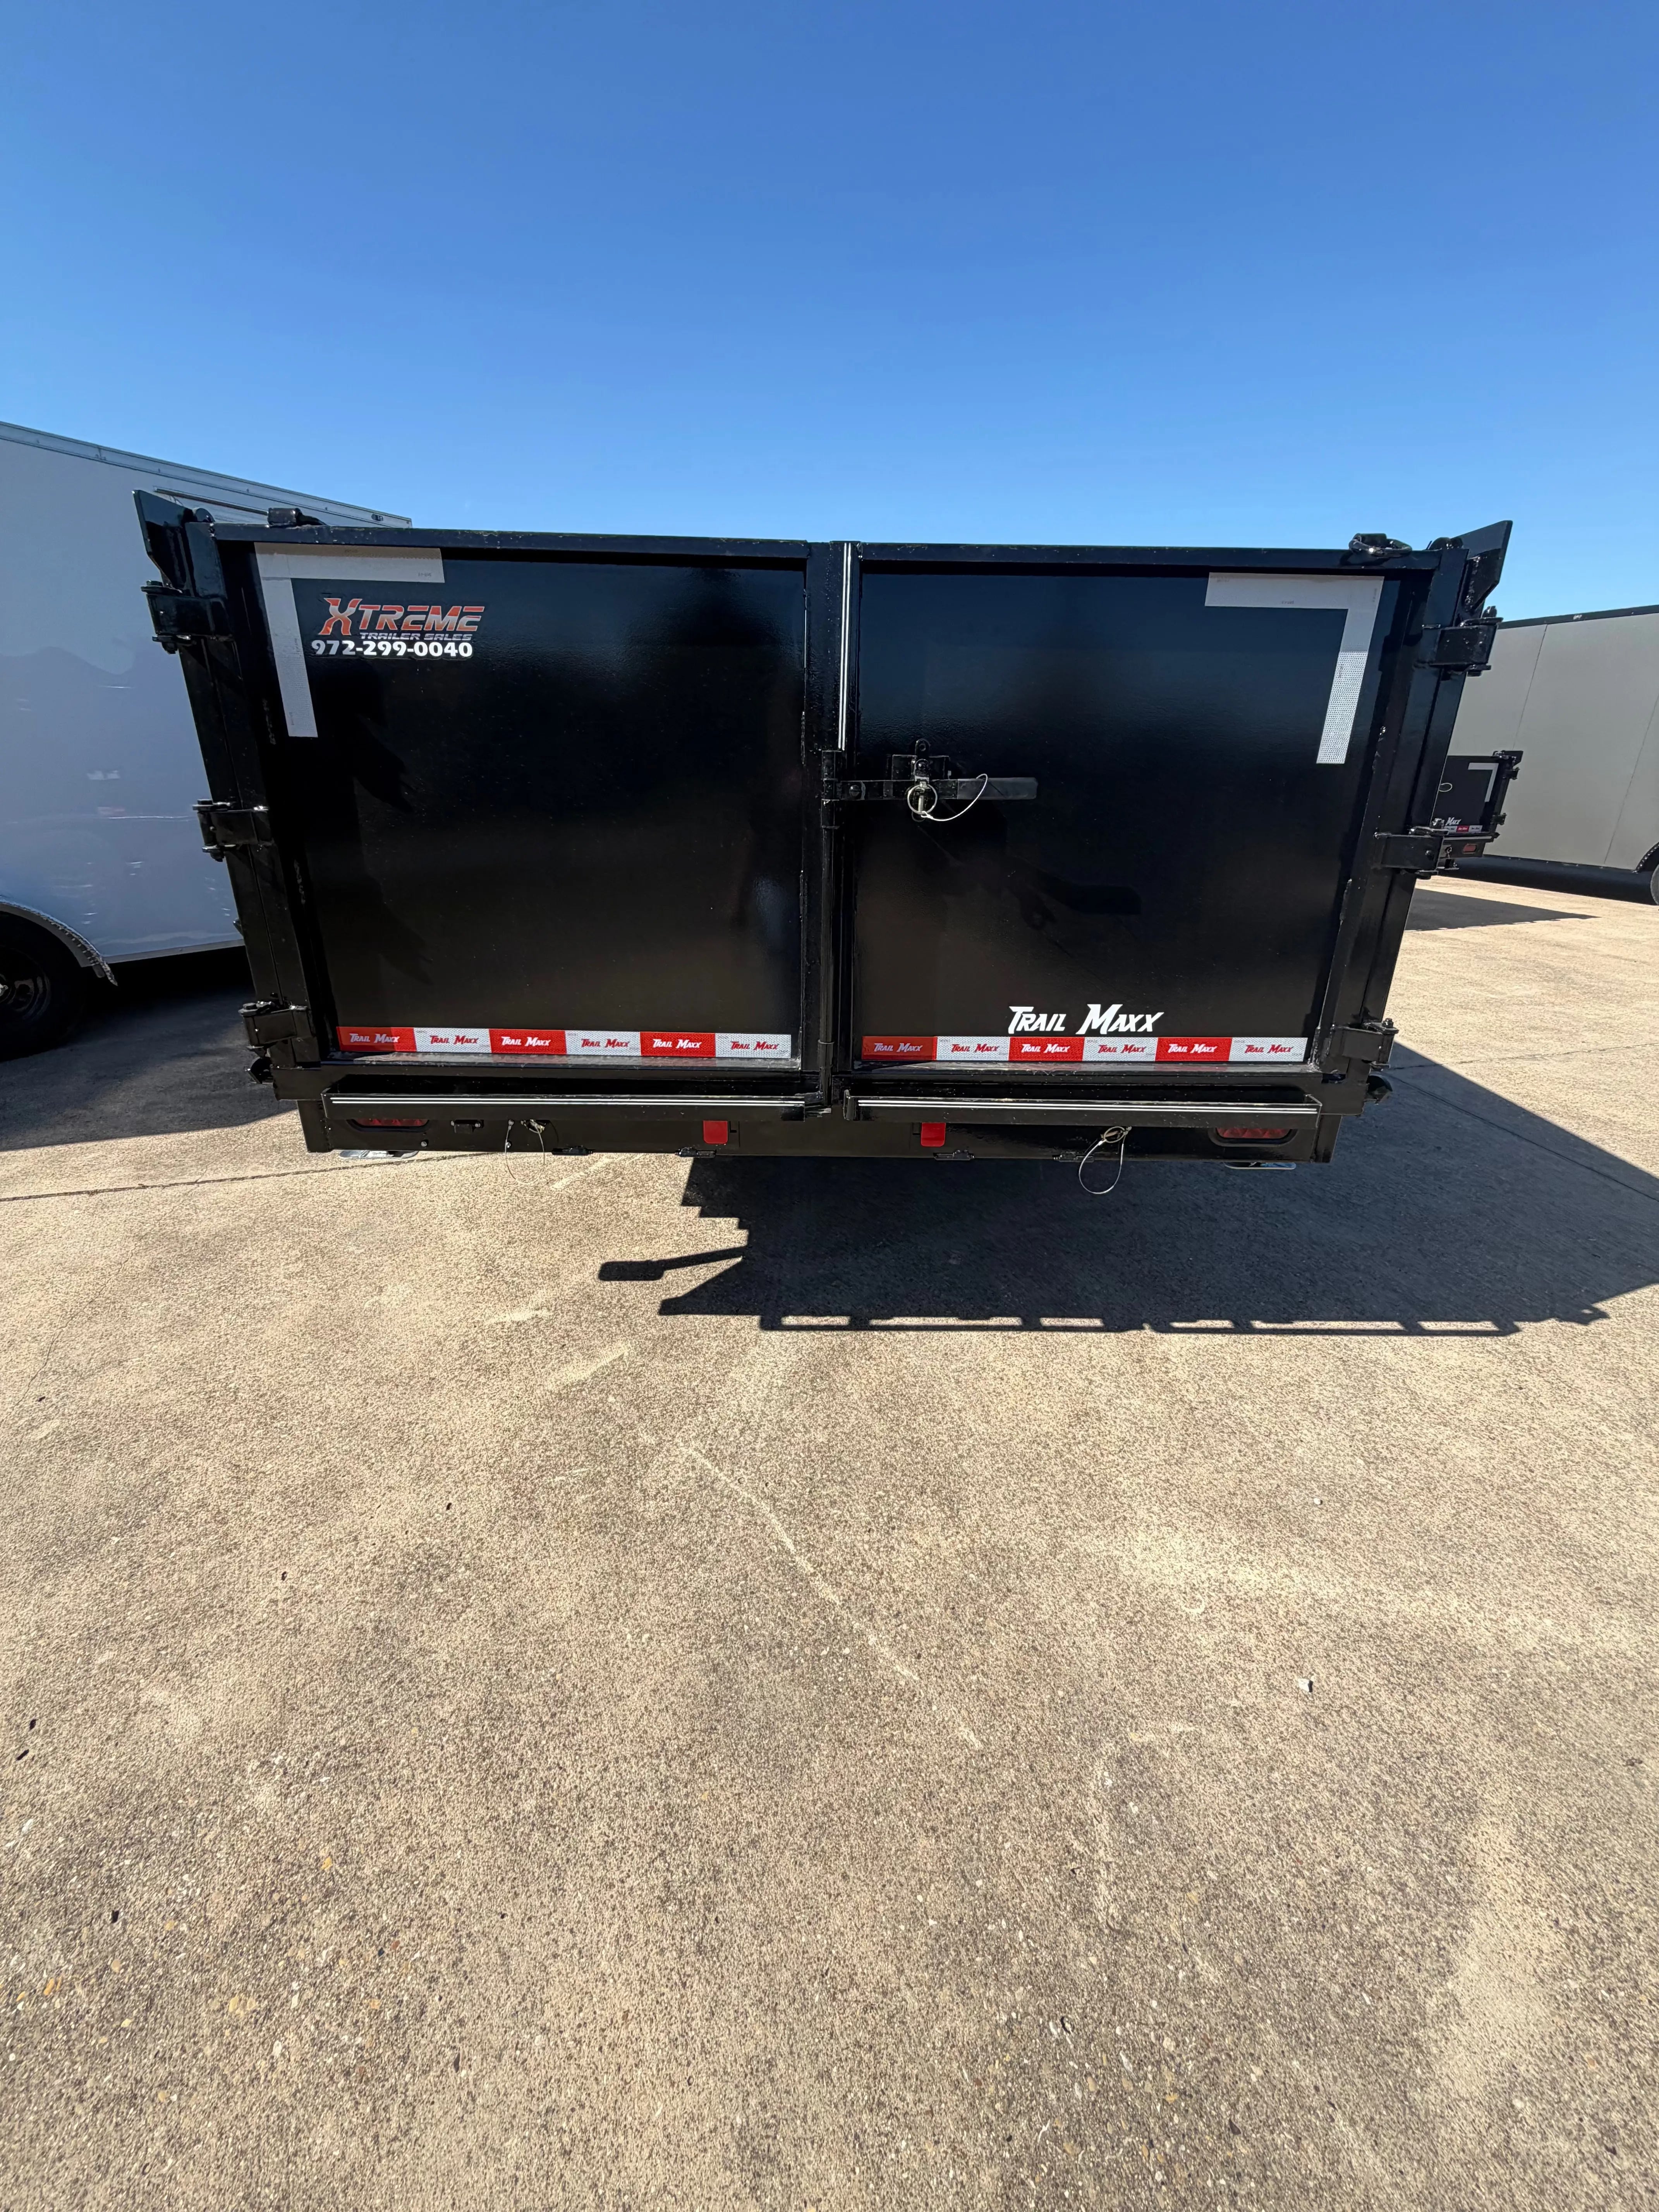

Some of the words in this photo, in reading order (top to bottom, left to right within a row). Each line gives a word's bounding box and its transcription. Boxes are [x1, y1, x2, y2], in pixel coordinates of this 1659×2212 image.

[318, 598, 485, 635] XTREME
[311, 639, 472, 657] 972-299-0040
[1008, 1006, 1066, 1034] TRAIL
[1075, 1004, 1164, 1034] MAXX
[350, 1034, 370, 1042] TRAIL
[374, 1034, 400, 1043] MAXX
[430, 1036, 449, 1044] TRAIL
[453, 1036, 478, 1044] MAXX
[501, 1036, 521, 1046] TRAIL
[525, 1037, 551, 1046] MAXX
[581, 1039, 600, 1047] TRAIL
[605, 1039, 629, 1048] MAXX
[653, 1039, 672, 1048] TRAIL
[676, 1039, 702, 1049] MAXX
[731, 1041, 750, 1049] TRAIL
[754, 1041, 778, 1050] MAXX
[874, 1043, 893, 1052] TRAIL
[896, 1043, 922, 1052] MAXX
[951, 1044, 970, 1053] TRAIL
[974, 1044, 1000, 1053] MAXX
[1021, 1044, 1041, 1053] TRAIL
[1044, 1044, 1070, 1053] MAXX
[1098, 1044, 1117, 1053] TRAIL
[1121, 1044, 1146, 1053] MAXX
[1168, 1044, 1188, 1053] TRAIL
[1190, 1044, 1218, 1053] MAXX
[1244, 1044, 1264, 1053] TRAIL
[1267, 1044, 1293, 1053] MAXX
